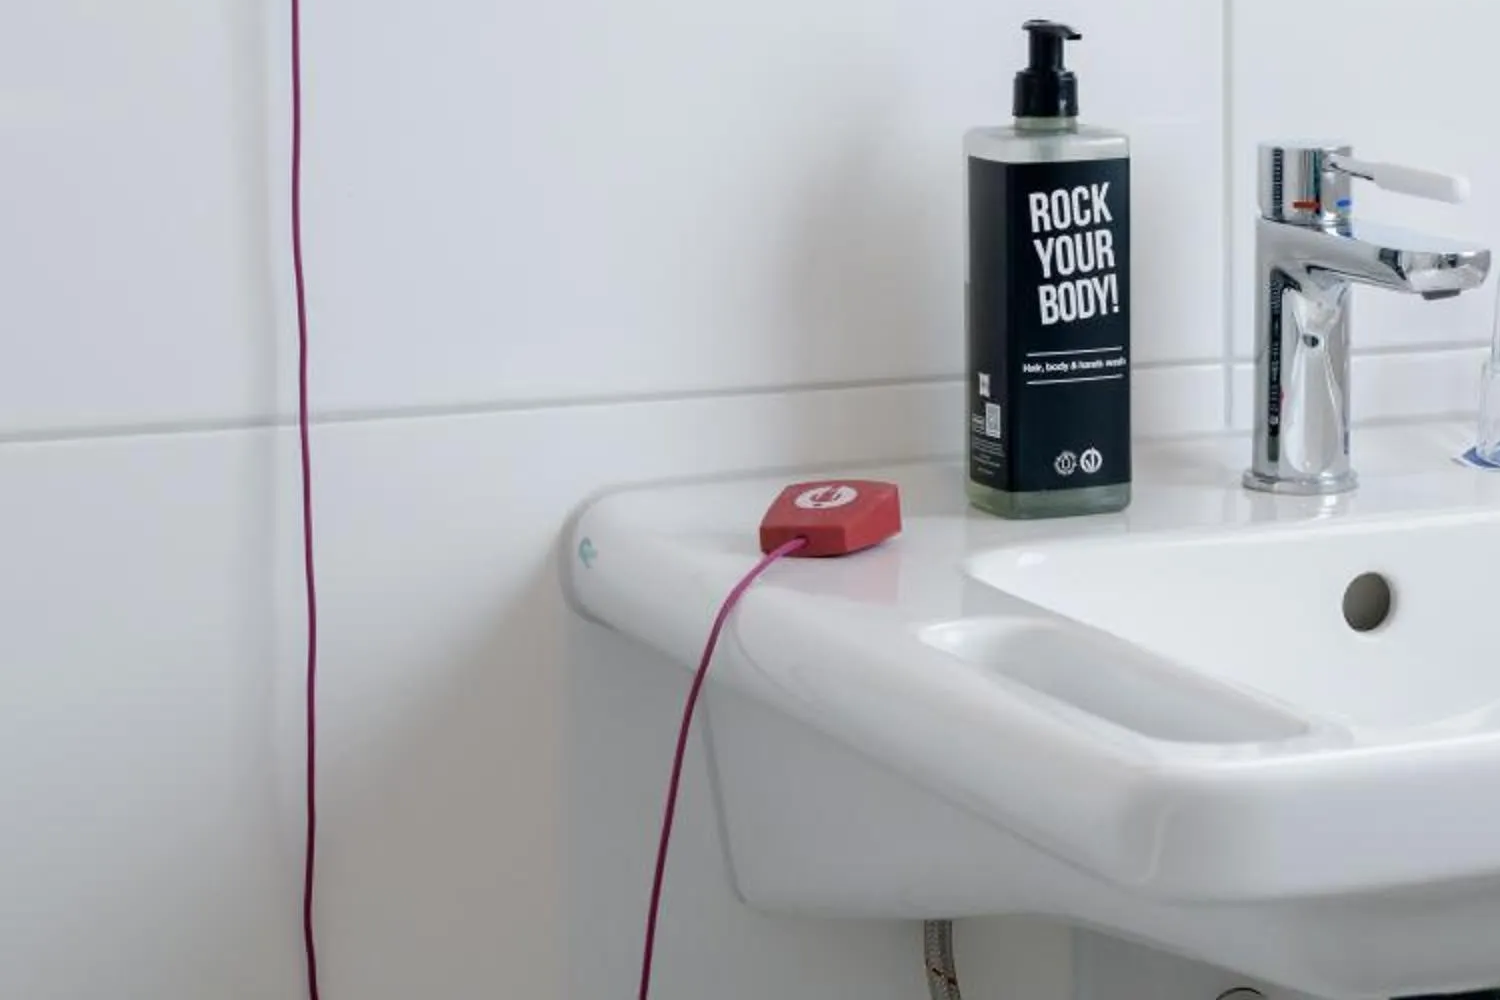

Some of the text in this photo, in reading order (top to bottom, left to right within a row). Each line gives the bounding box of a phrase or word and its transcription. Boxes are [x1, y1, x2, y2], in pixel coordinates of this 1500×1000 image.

[1028, 181, 1113, 232] ROCK
[1033, 229, 1115, 279] YOUR
[1038, 273, 1120, 325] BODY!
[1023, 363, 1045, 373] Hair,
[1045, 362, 1068, 372] body
[1070, 361, 1077, 370] &
